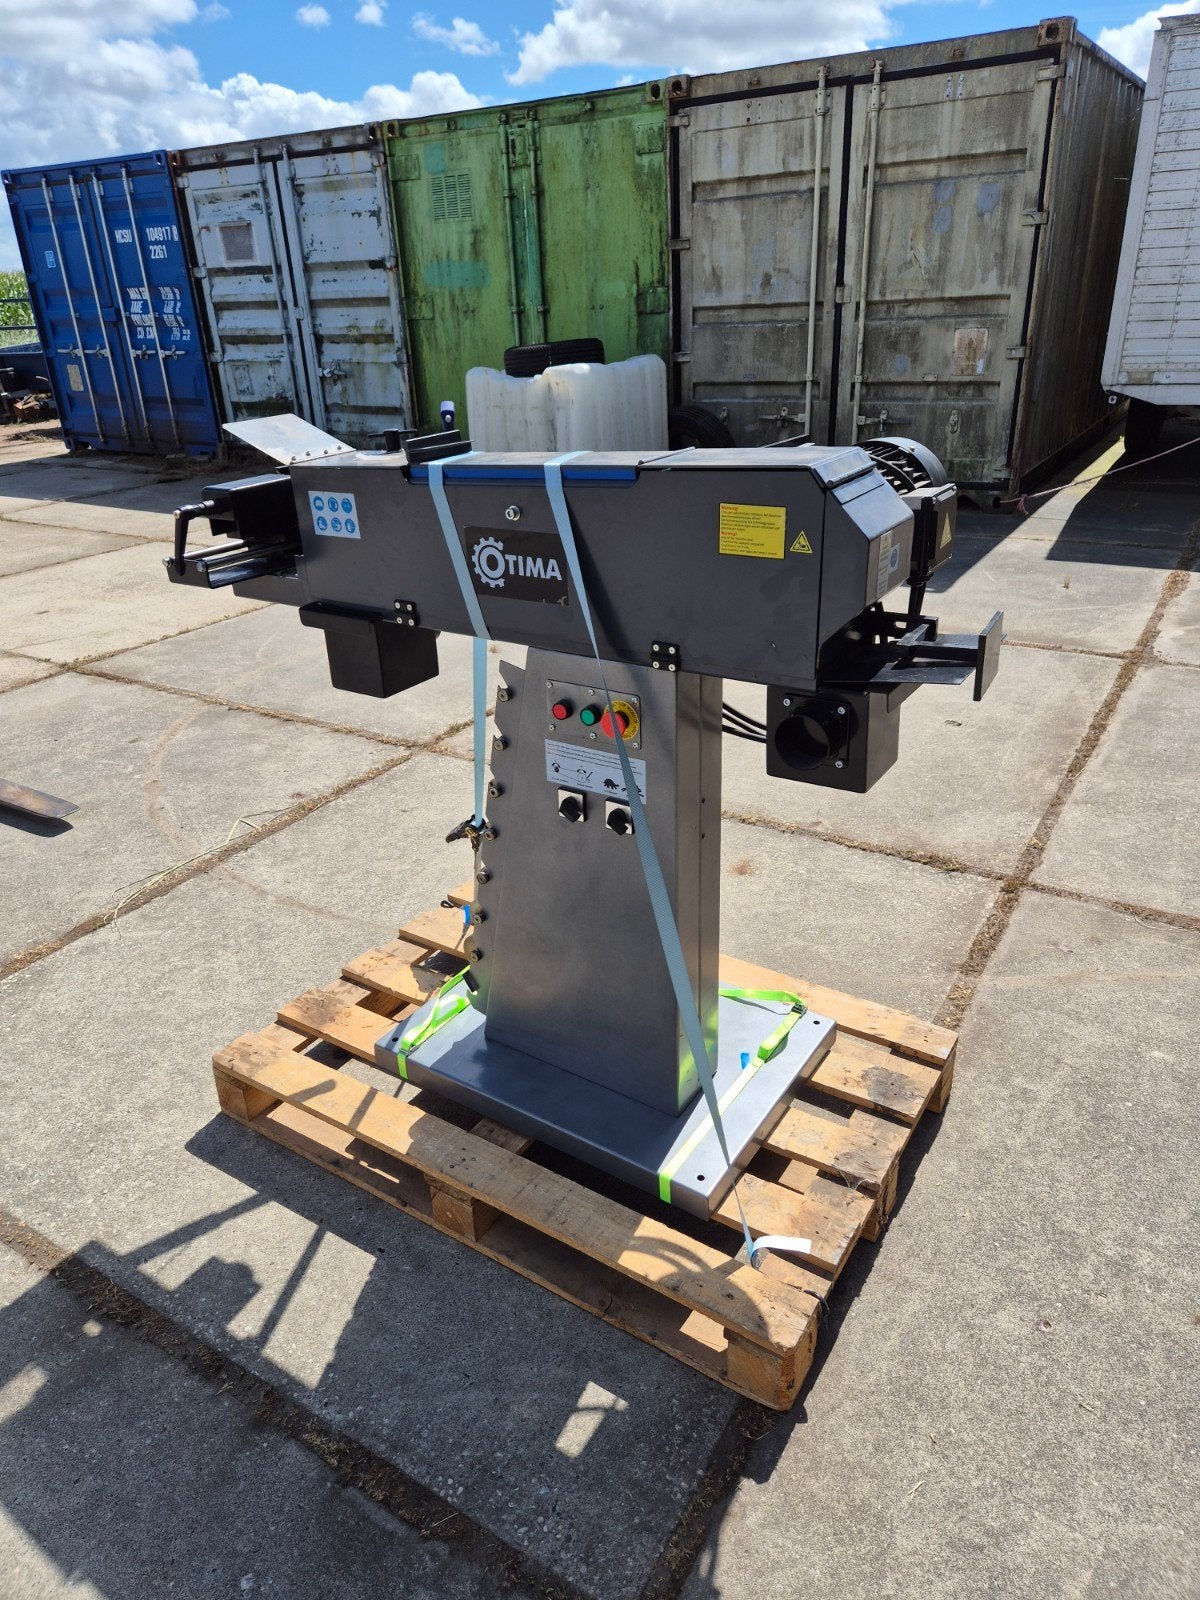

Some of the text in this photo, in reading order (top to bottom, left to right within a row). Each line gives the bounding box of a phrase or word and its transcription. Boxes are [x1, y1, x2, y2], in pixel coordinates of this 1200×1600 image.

[146, 226, 171, 242] 104917
[149, 244, 168, 259] 22G1
[476, 543, 563, 584] OTIMA
